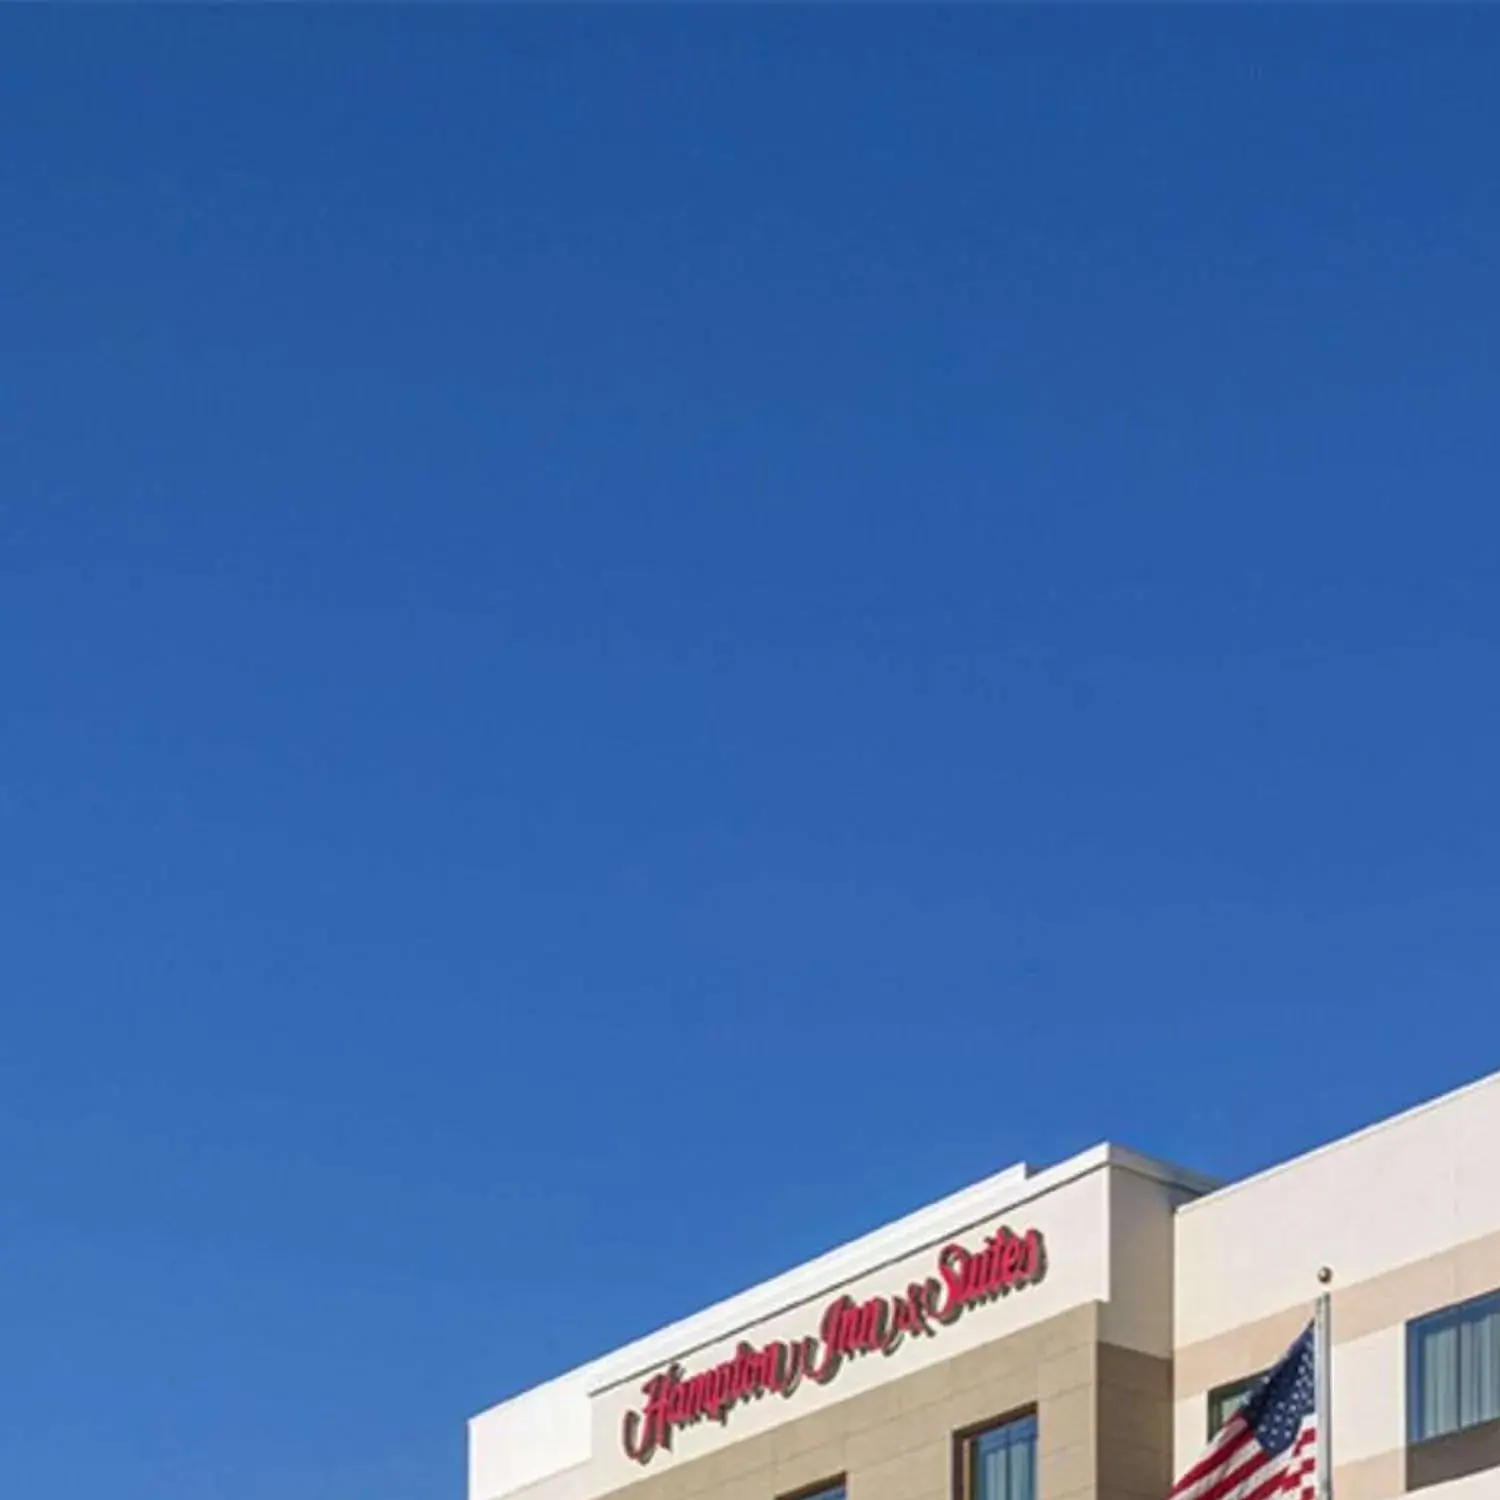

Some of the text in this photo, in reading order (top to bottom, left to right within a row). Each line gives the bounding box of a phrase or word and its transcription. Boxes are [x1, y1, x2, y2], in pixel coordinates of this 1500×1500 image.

[622, 1341, 800, 1464] Hampton
[802, 1295, 905, 1384] Inn
[925, 1224, 1047, 1325] Suites
